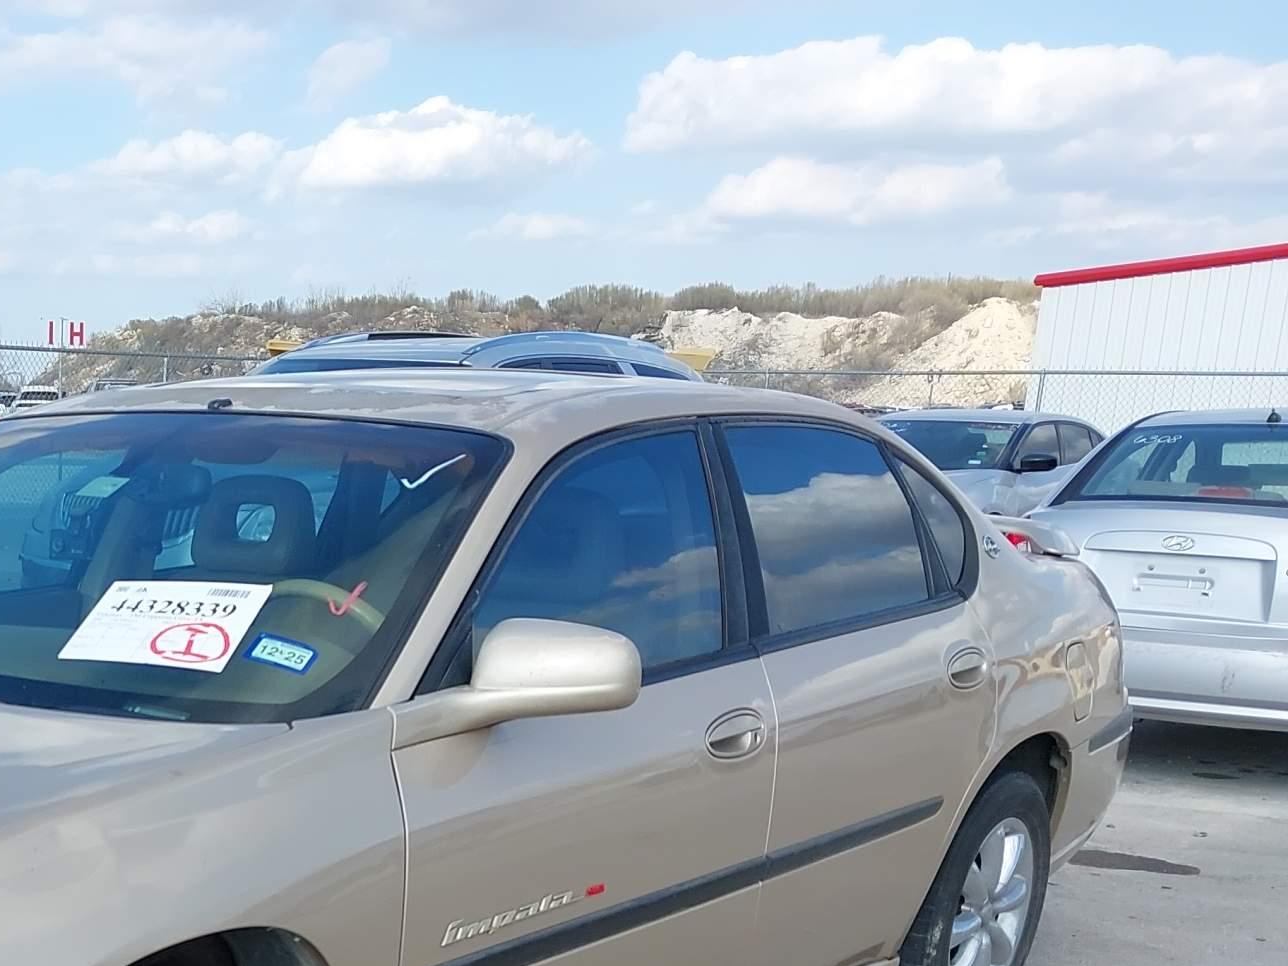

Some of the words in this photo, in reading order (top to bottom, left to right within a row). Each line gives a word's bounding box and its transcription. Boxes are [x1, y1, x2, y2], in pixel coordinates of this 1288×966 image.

[69, 321, 84, 346] H
[111, 598, 237, 619] 44328339
[440, 891, 574, 947] Impala
